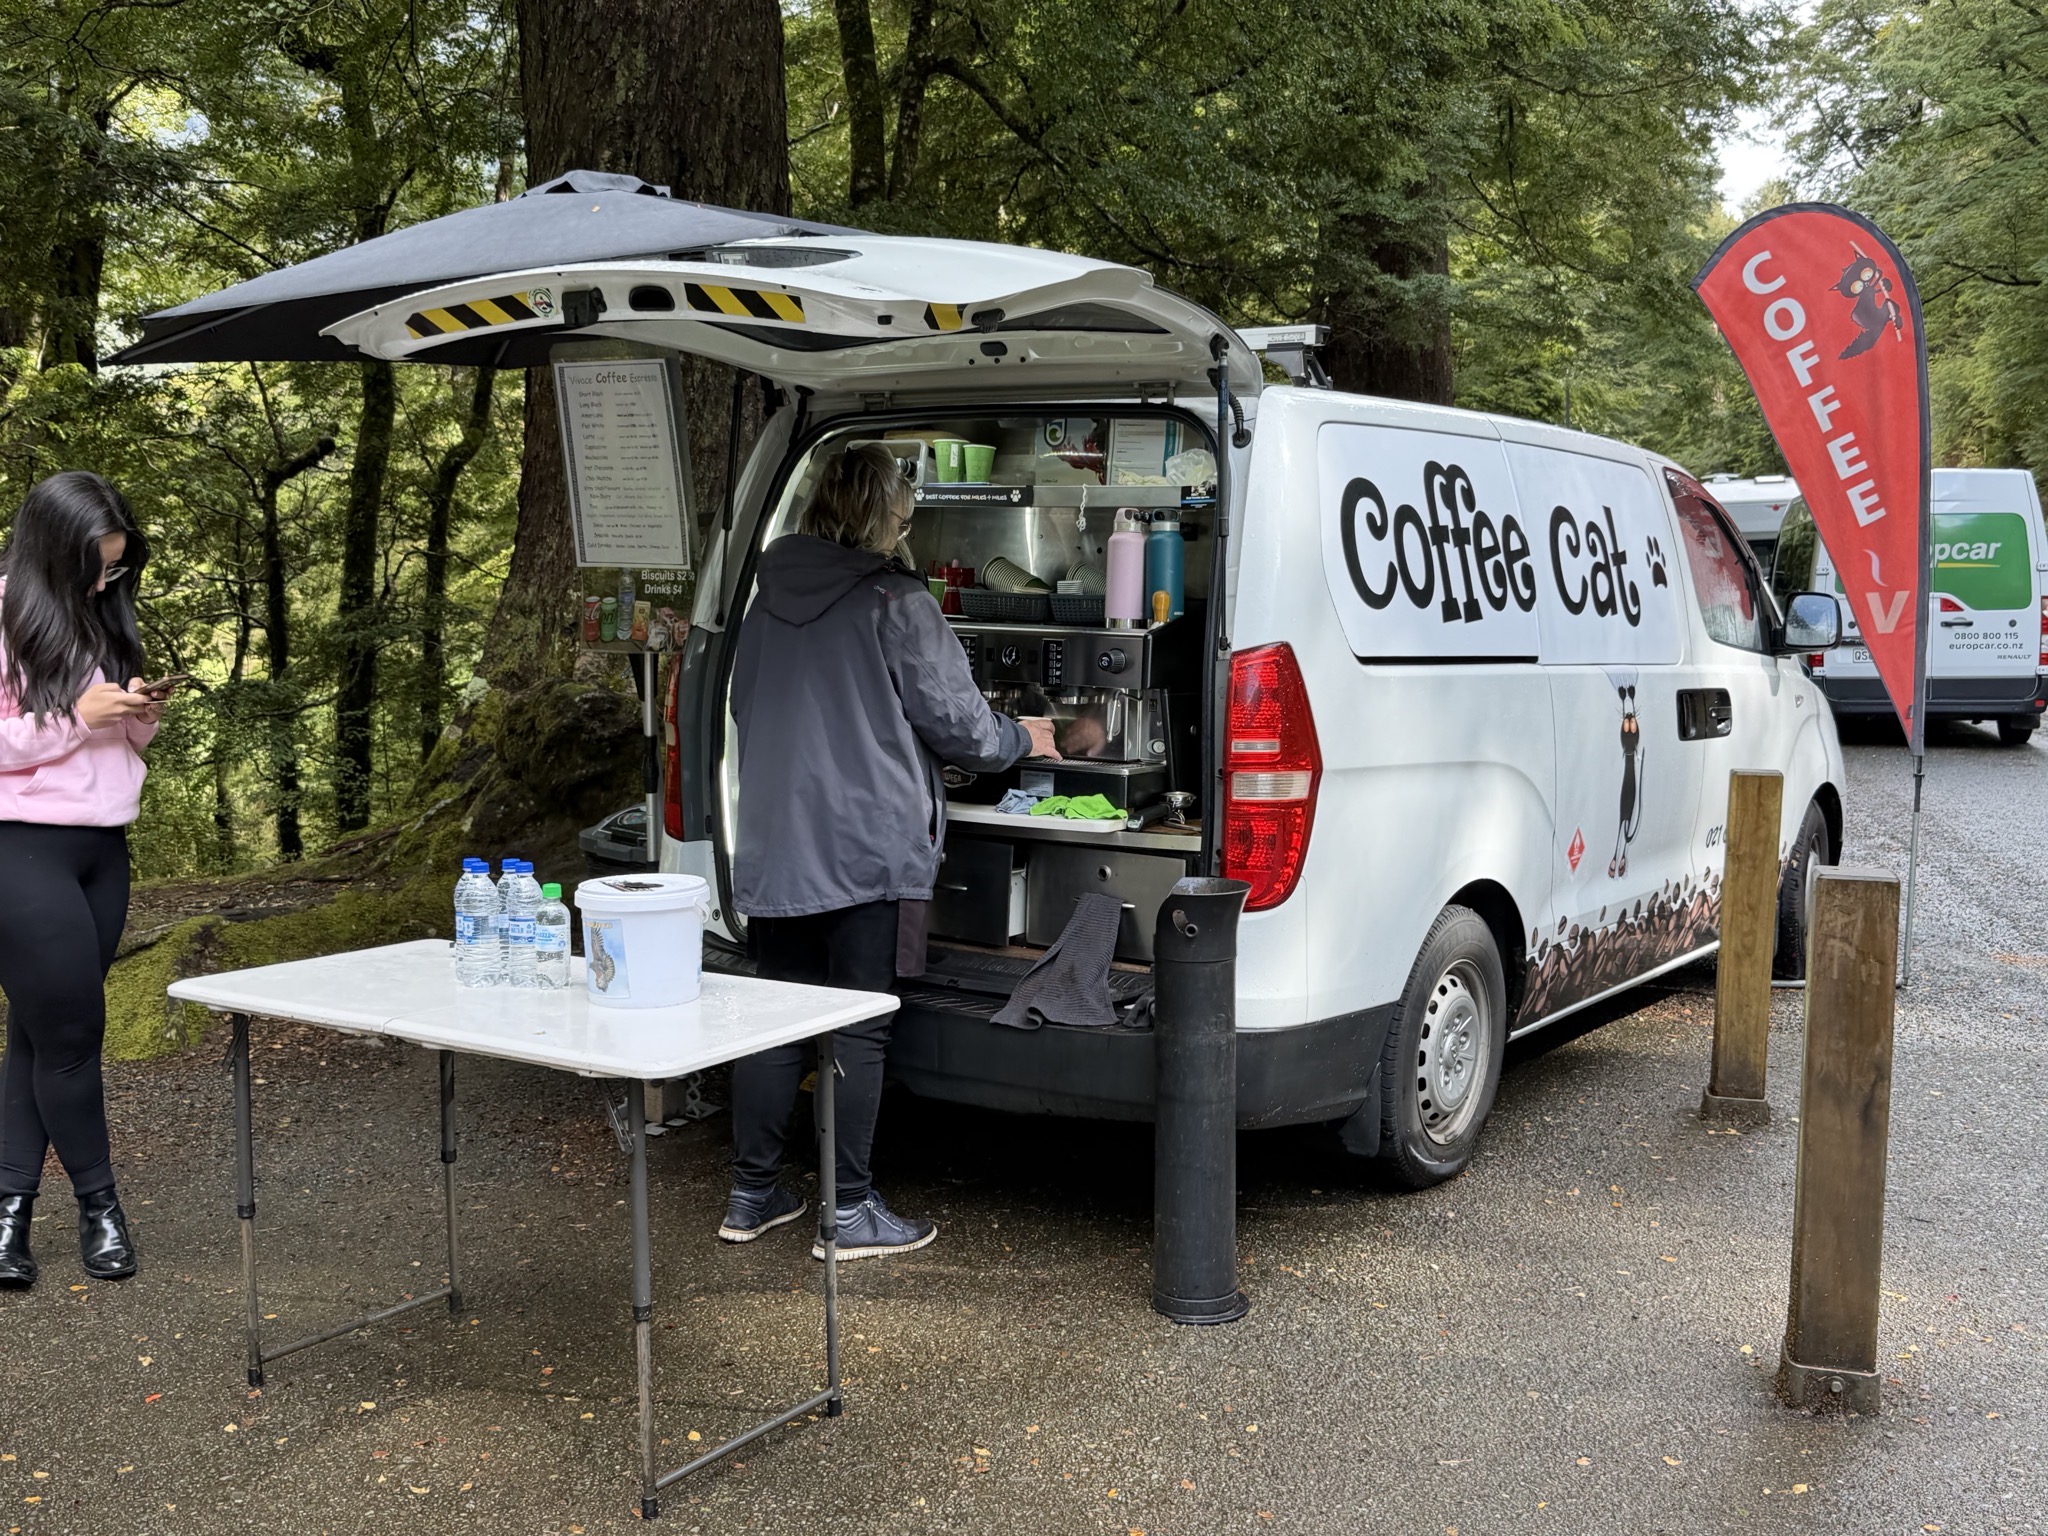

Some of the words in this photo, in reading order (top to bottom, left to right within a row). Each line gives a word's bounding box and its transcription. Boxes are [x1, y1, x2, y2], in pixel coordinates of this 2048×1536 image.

[595, 371, 628, 384] Coffee
[1741, 249, 1887, 528] COFFEE
[1340, 460, 1537, 624] Coffee
[1549, 505, 1641, 628] Cat
[1930, 541, 2002, 569] pcar
[641, 570, 675, 581] Biscuits
[644, 584, 671, 594] Drinks
[1954, 632, 1980, 640] 0800
[1982, 632, 2001, 640] 800
[2004, 632, 2019, 640] 115
[1949, 642, 2024, 651] europcar.co.nz
